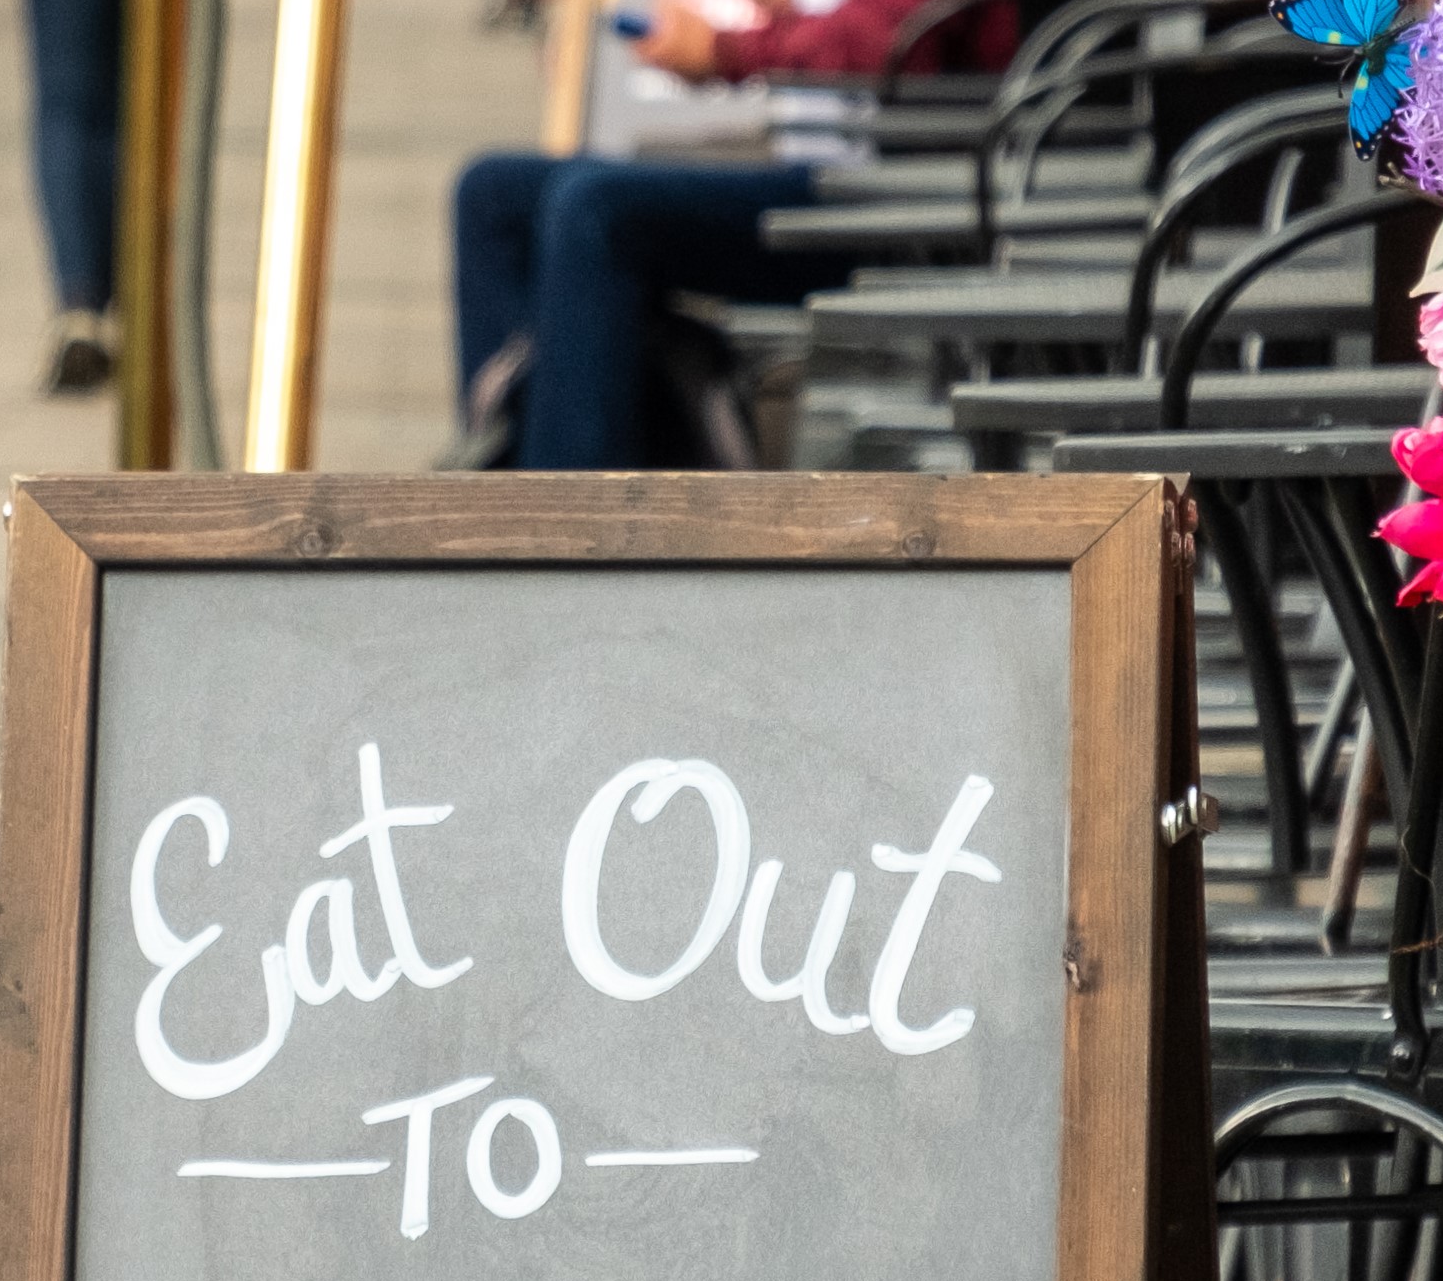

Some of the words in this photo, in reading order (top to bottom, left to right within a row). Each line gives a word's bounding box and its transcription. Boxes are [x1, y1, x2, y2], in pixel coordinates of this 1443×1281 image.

[130, 743, 473, 1099] Eat
[560, 758, 1002, 1056] Out
[360, 1075, 563, 1240] TO
